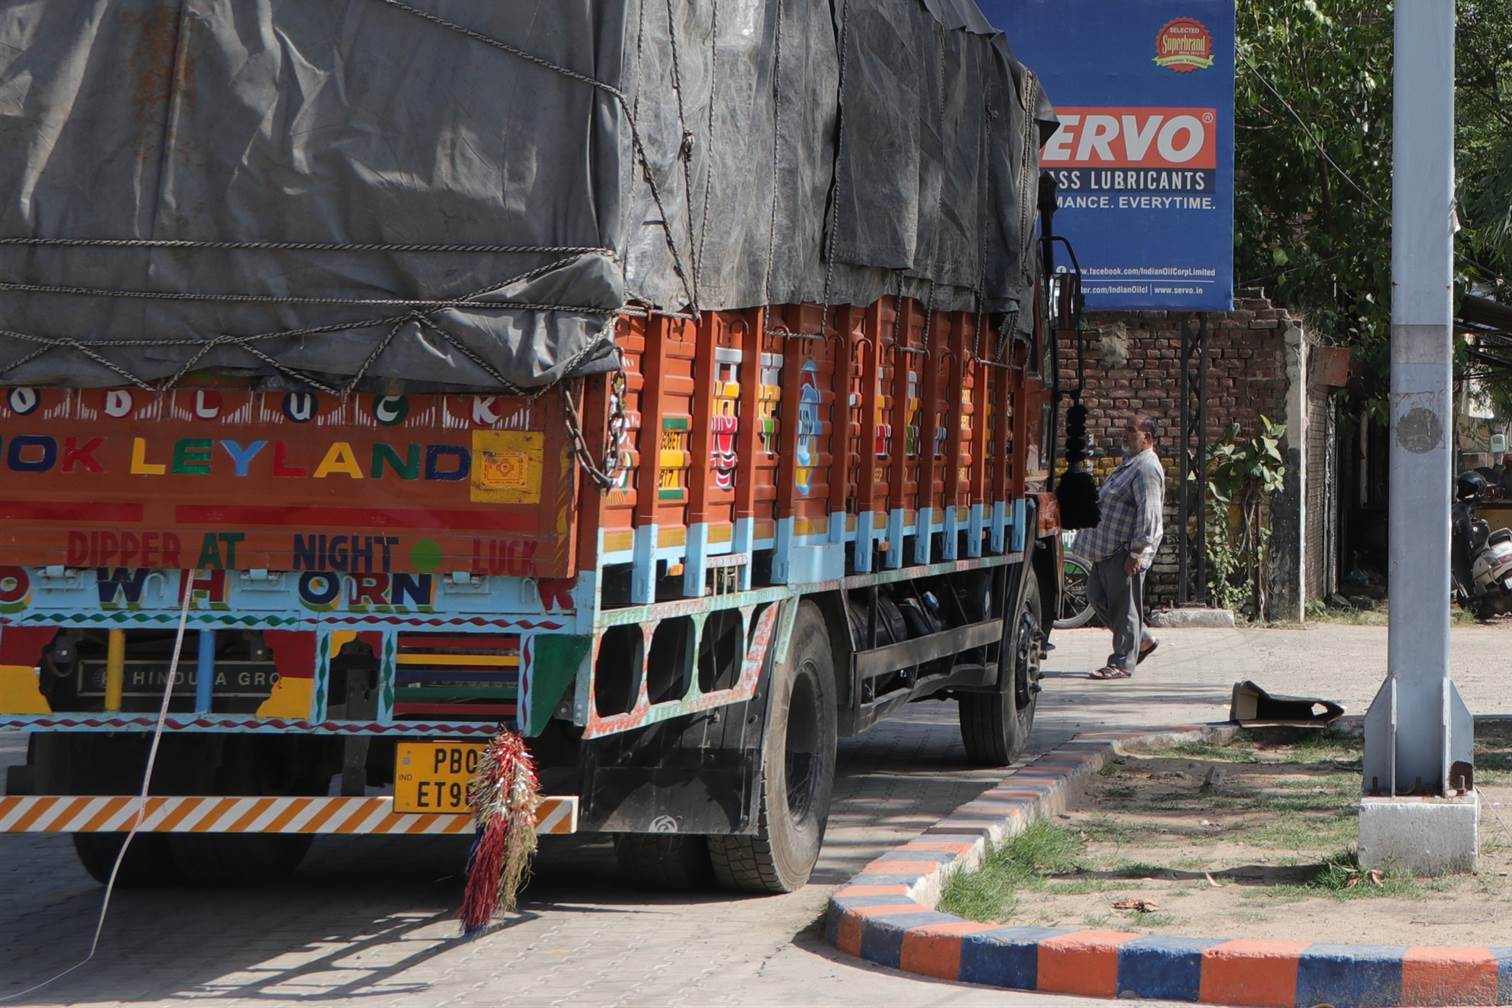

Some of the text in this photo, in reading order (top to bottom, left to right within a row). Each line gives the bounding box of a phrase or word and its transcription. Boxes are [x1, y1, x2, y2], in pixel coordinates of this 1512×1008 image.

[1169, 26, 1200, 34] SELECTED
[1162, 34, 1206, 55] Superbrand
[1042, 114, 1205, 163] ERVO
[1091, 171, 1205, 190] LUBRICANTS
[131, 436, 471, 481] LEYLAND
[66, 530, 182, 568] DIPPER
[197, 532, 244, 570] AT
[293, 534, 399, 572] NIGHT
[132, 671, 227, 686] HINDUA
